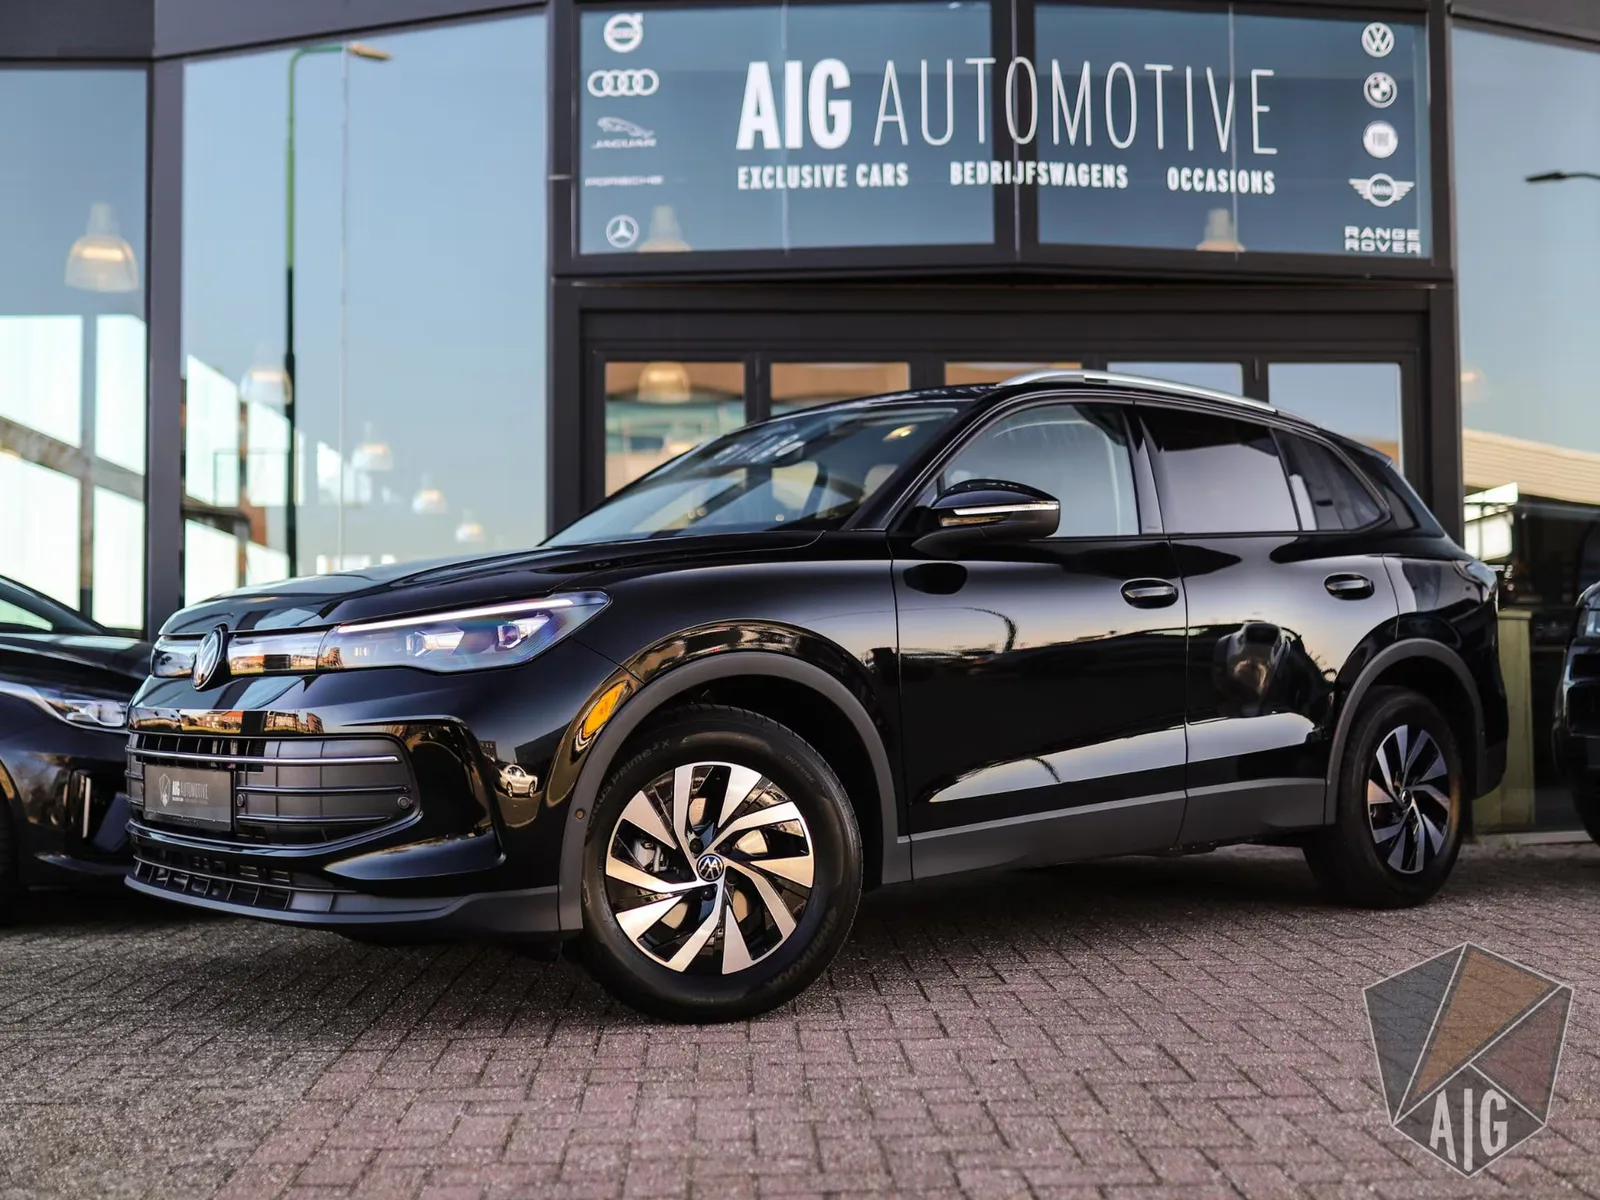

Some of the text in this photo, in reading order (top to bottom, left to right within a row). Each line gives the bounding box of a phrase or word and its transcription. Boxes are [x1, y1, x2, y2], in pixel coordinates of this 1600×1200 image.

[736, 57, 1278, 155] AIG AUTOMOTIVE
[737, 162, 909, 190] EXCLUSIVE CARS
[950, 160, 1128, 189] BEDRIJFSWAGENS
[1167, 167, 1276, 194] OCCASIONS
[1344, 225, 1420, 241] RANGE
[1344, 238, 1421, 254] ROVER
